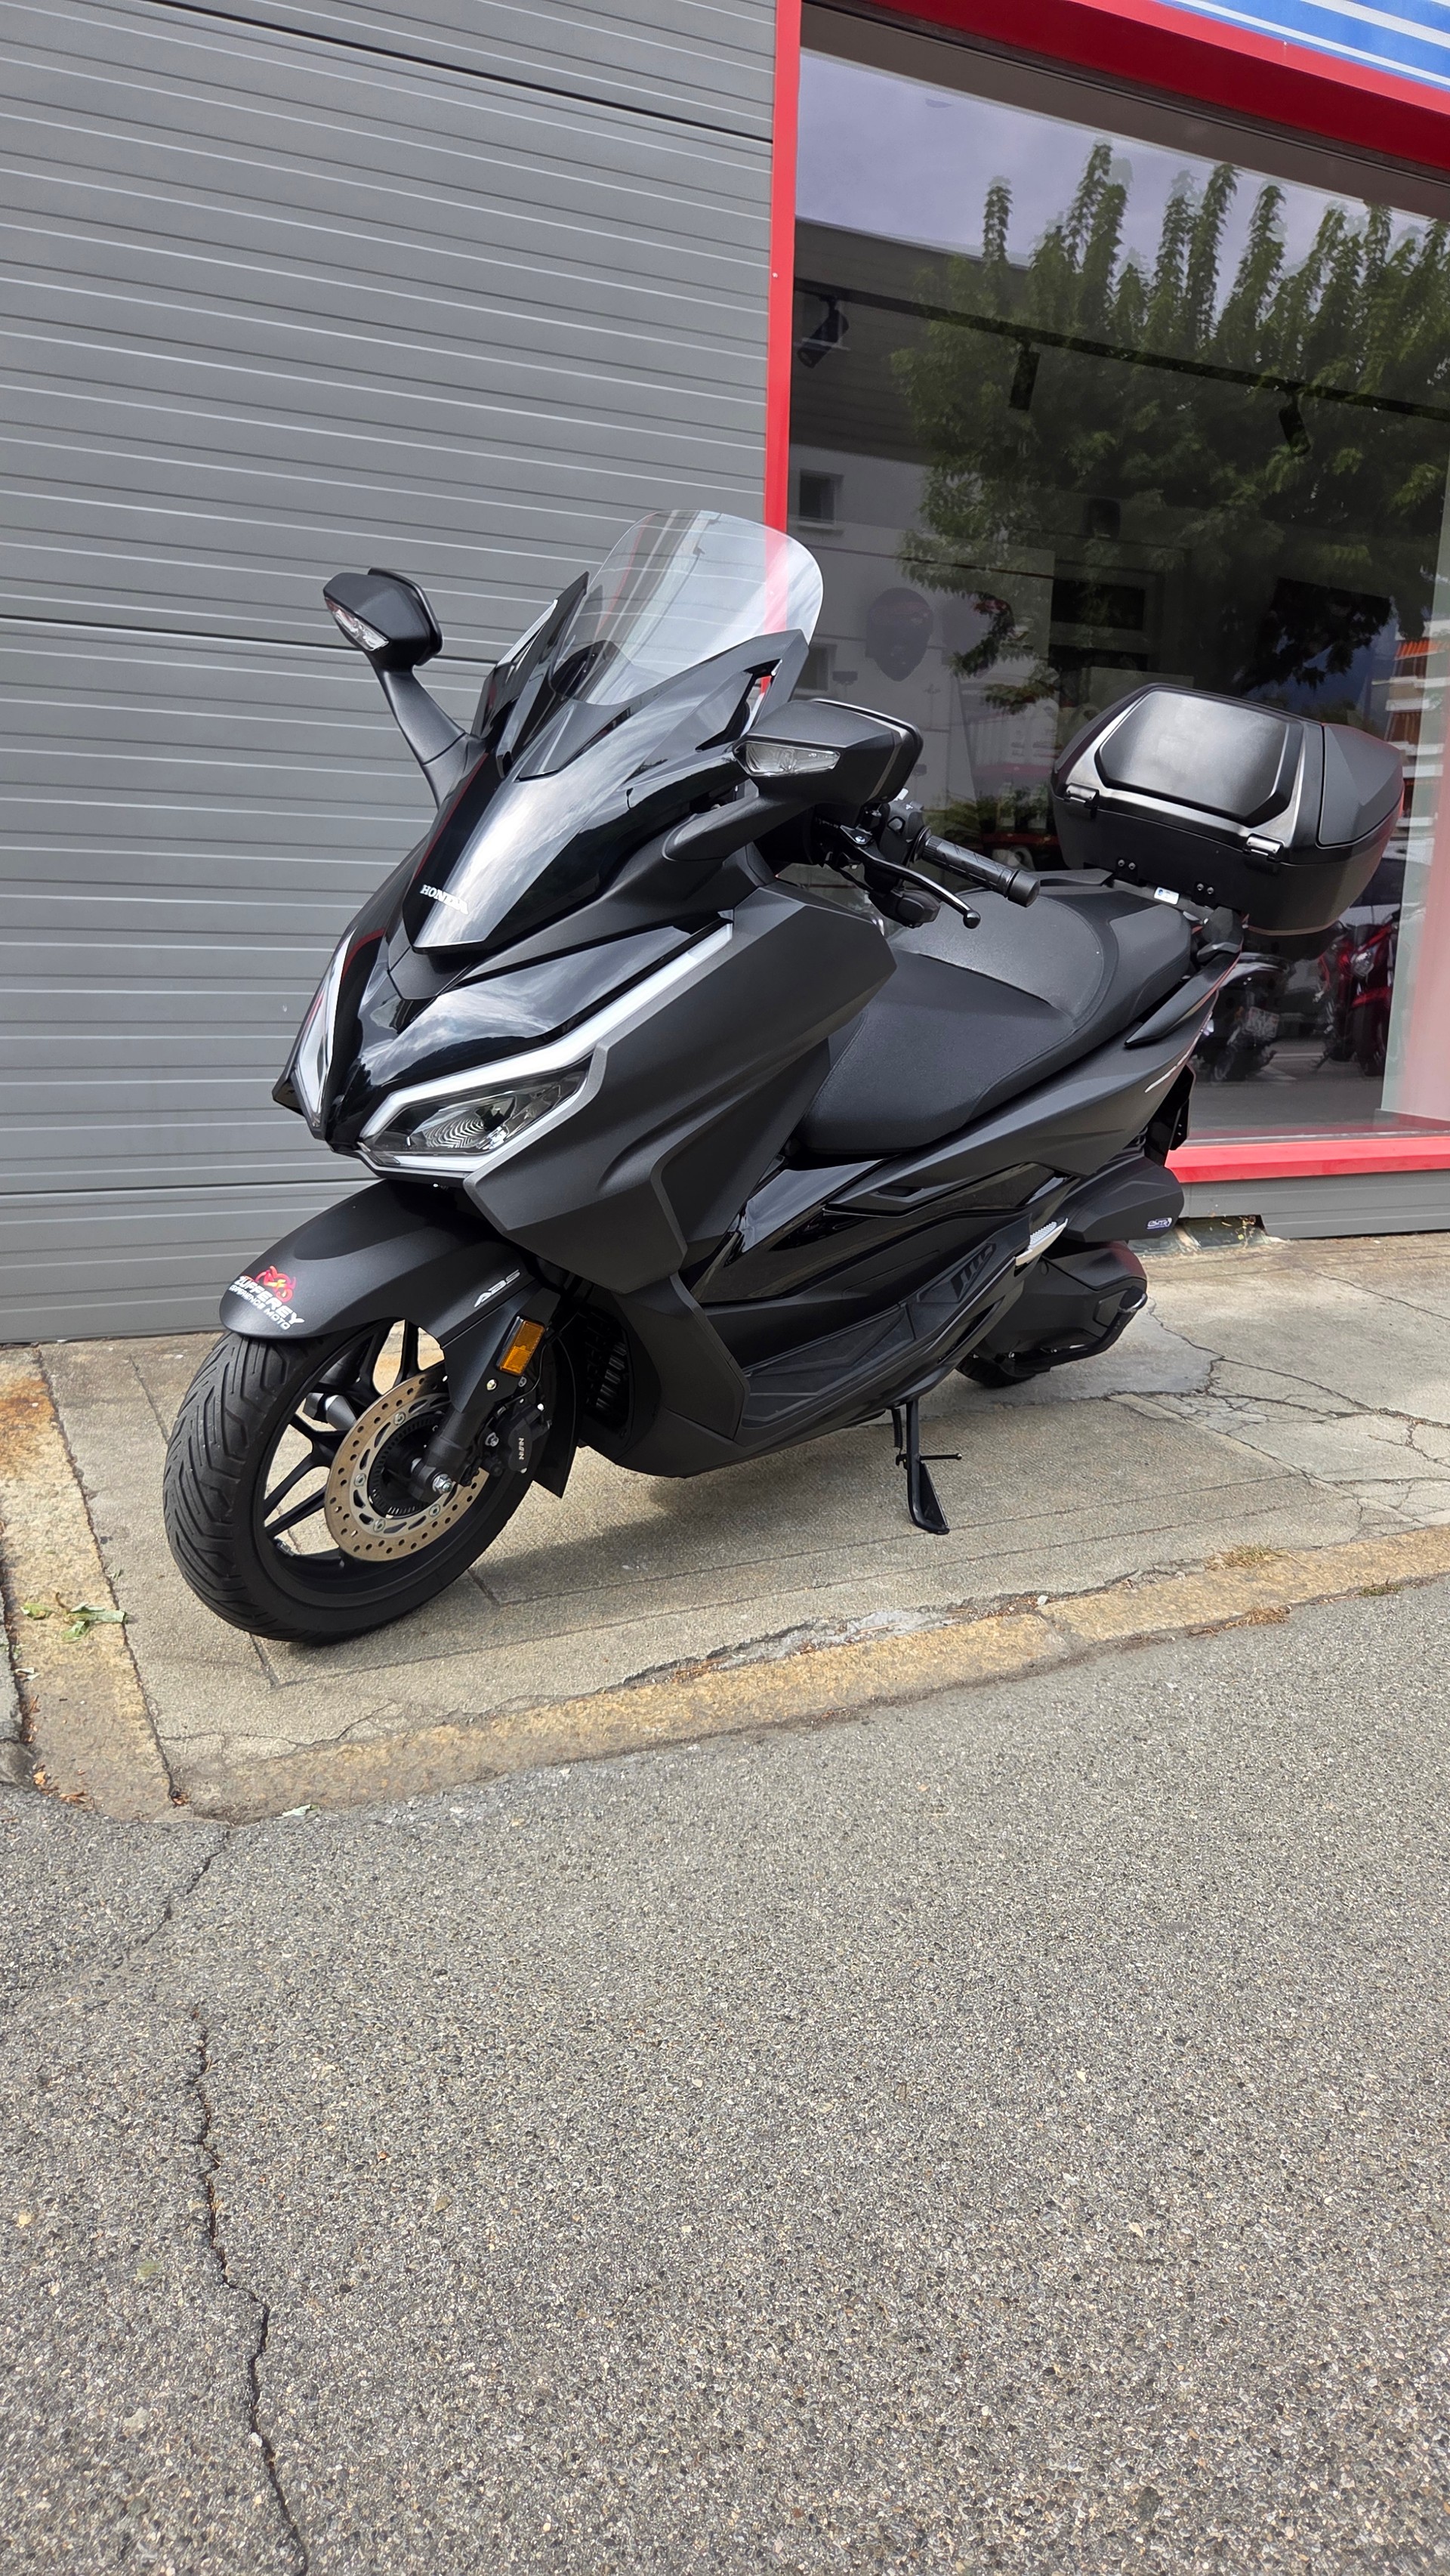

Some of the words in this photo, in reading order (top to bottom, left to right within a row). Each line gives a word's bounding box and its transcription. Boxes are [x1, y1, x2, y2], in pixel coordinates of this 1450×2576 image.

[419, 885, 469, 915] HONDA
[234, 1275, 305, 1324] ZUFFEREY
[474, 1269, 520, 1308] ABS
[263, 1308, 291, 1330] MOTO
